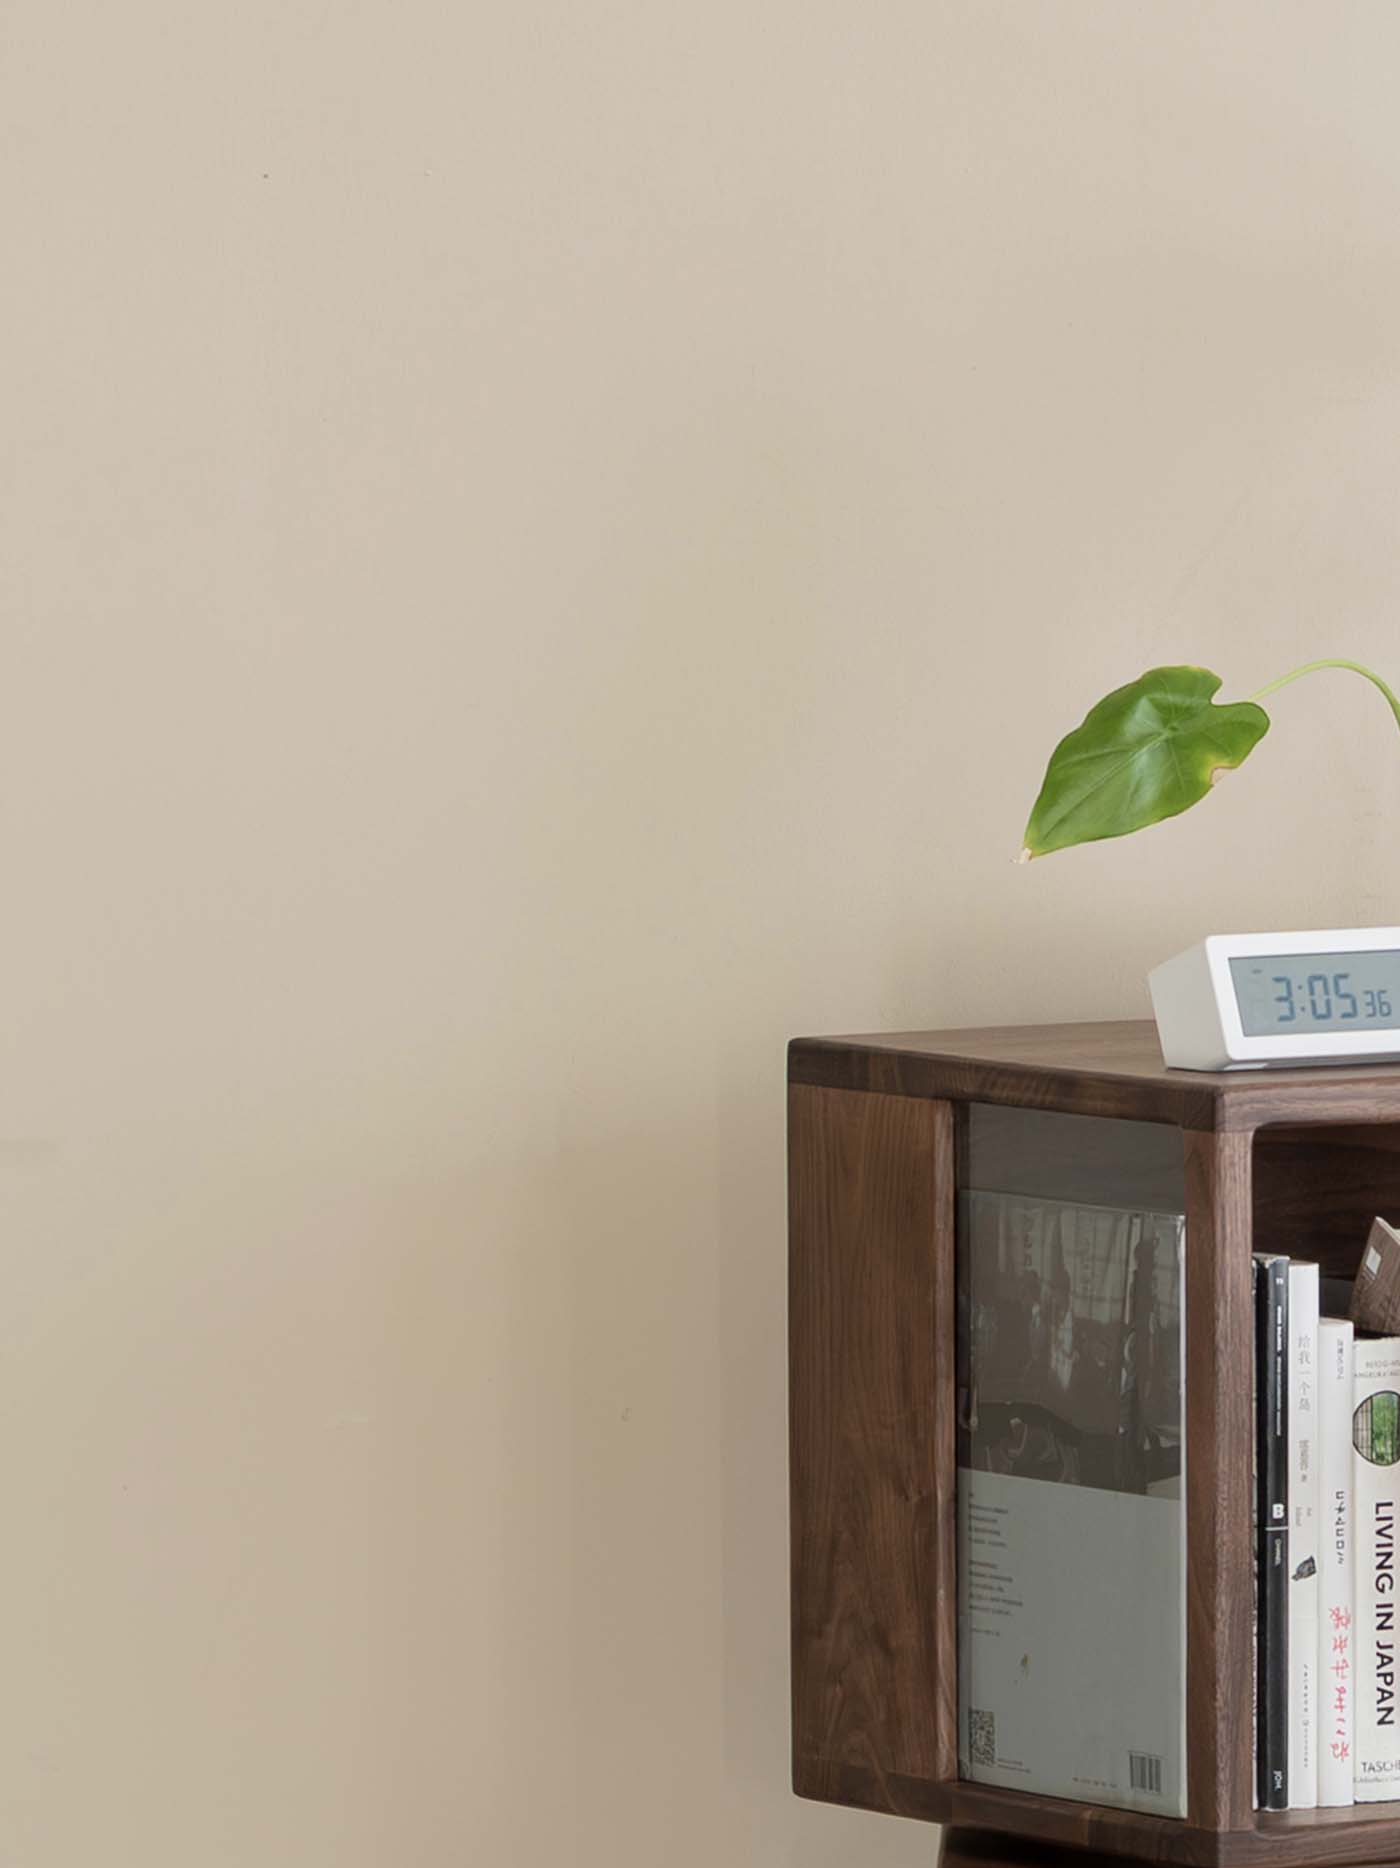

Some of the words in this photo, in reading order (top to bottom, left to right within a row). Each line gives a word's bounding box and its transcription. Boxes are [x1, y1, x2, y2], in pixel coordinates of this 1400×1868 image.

[1272, 973, 1358, 1022] 3:05
[1363, 989, 1393, 1018] 36
[1272, 1503, 1285, 1519] B
[1375, 1501, 1394, 1593] LIVING
[1375, 1603, 1394, 1630] IN
[1375, 1640, 1394, 1725] JAPAN
